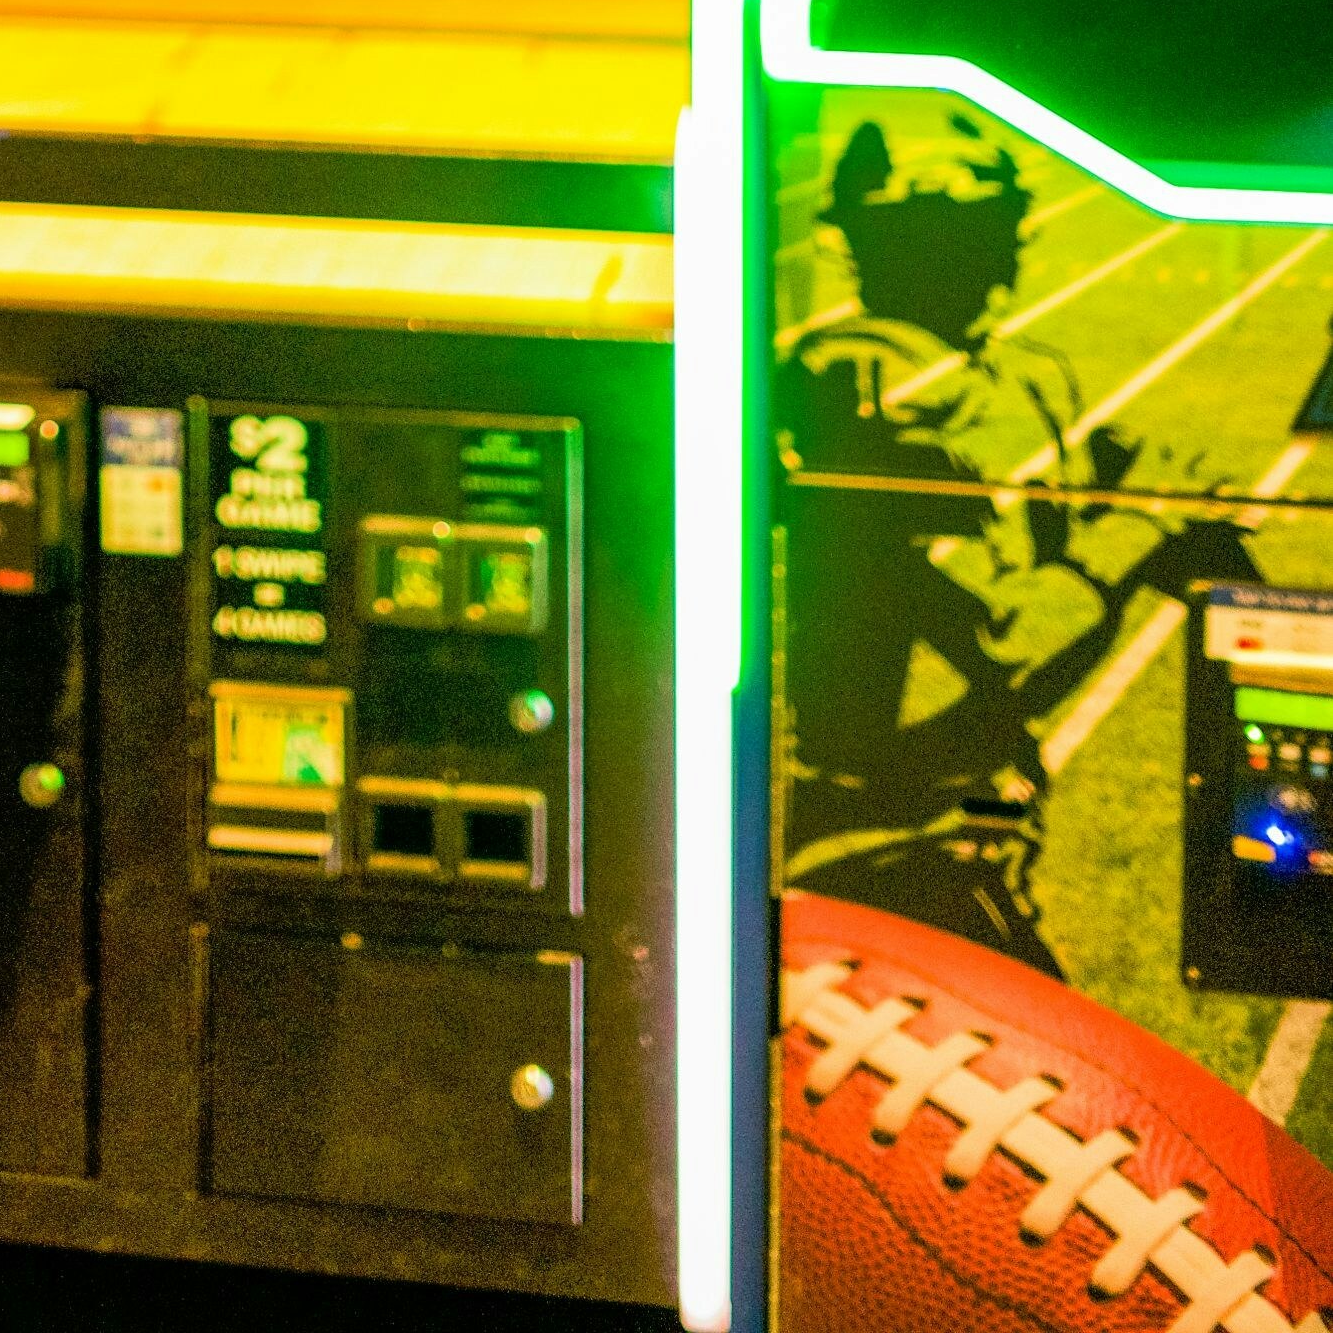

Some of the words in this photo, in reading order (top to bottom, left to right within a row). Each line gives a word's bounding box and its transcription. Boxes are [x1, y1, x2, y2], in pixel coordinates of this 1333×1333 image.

[229, 414, 308, 474] $2
[231, 467, 306, 500] PER
[216, 496, 322, 532] GAME
[235, 545, 326, 583] SWIPE
[235, 607, 327, 645] GAMES
